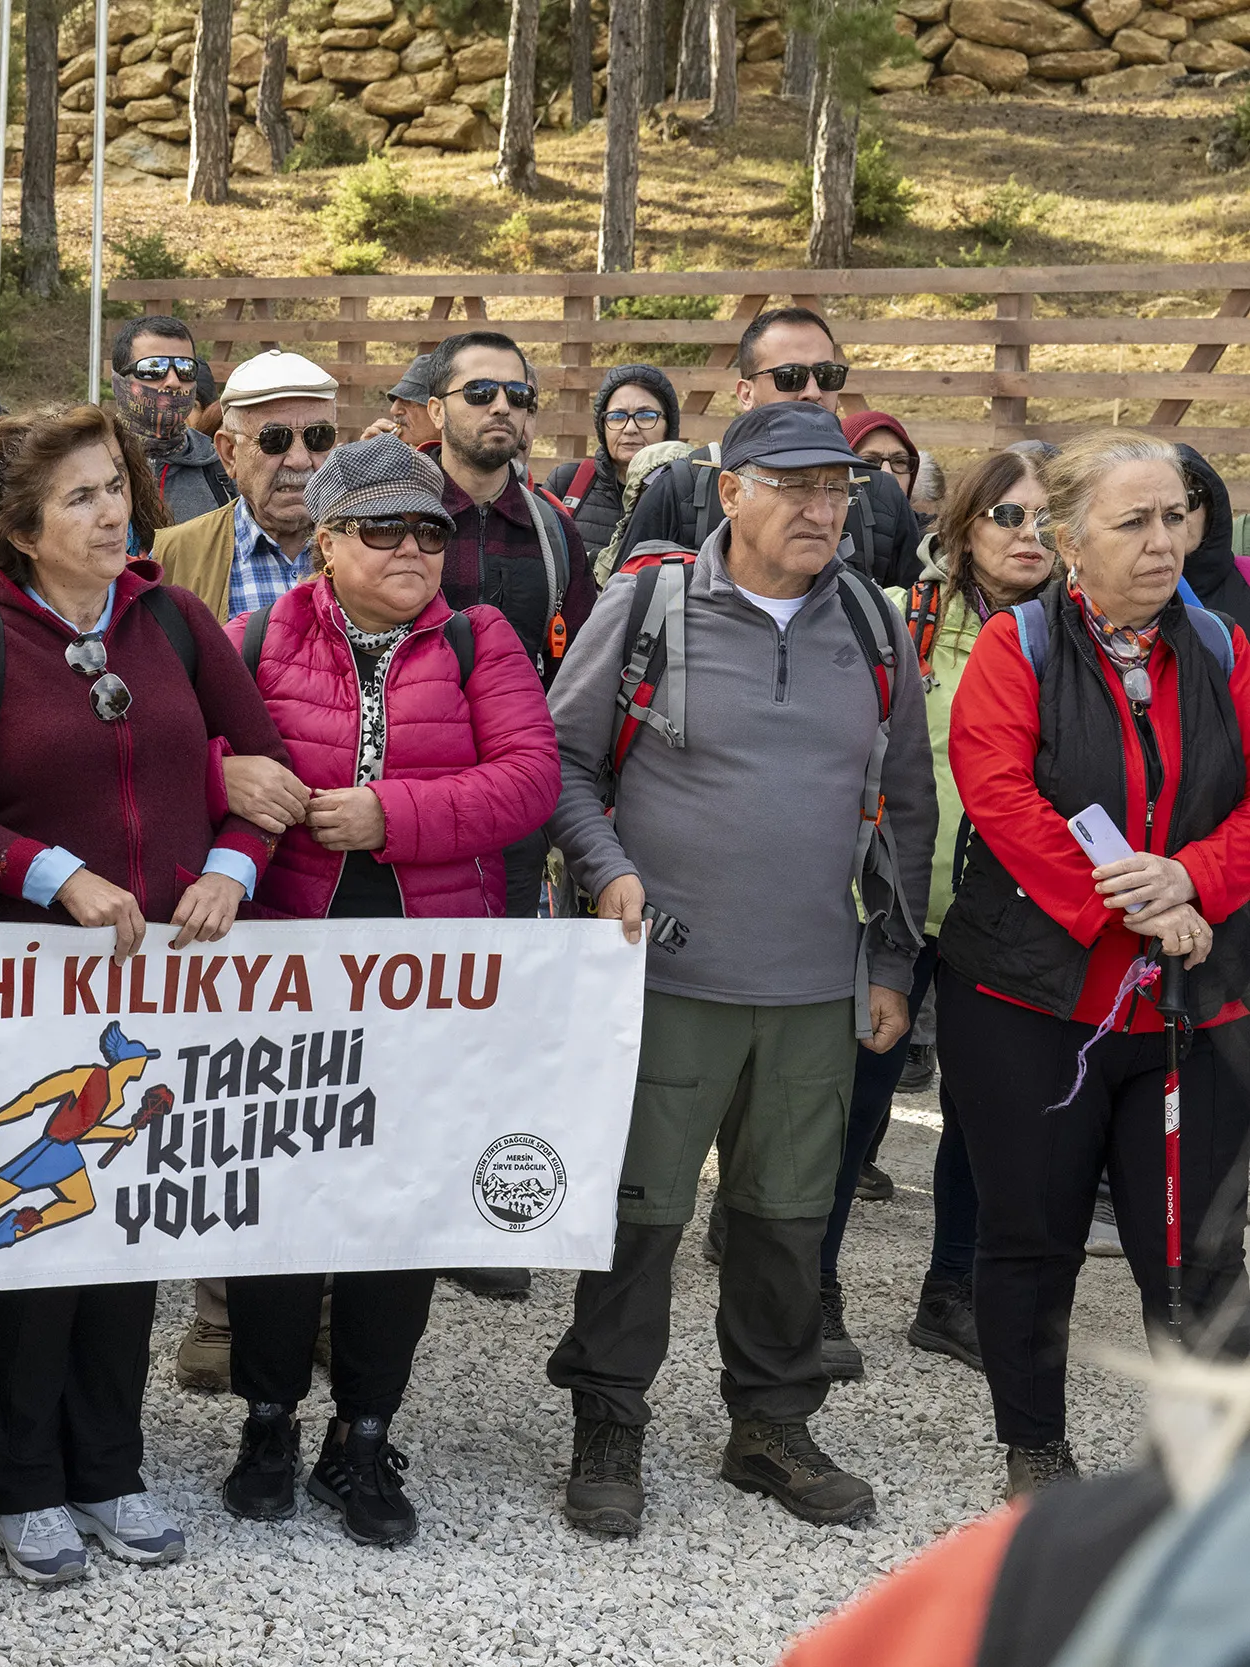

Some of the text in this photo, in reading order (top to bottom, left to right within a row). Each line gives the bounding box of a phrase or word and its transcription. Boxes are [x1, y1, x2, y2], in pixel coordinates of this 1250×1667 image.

[341, 953, 502, 1010] YOLU
[178, 1028, 364, 1104] TARİHİ
[147, 1087, 376, 1175] KİLİKYA
[506, 1153, 533, 1161] MERSİN
[476, 1158, 488, 1186] MERSİN
[486, 1141, 503, 1159] ZİRVE
[535, 1142, 553, 1158] SPOR
[492, 1163, 547, 1171] ZİRVE DAĞCILIK
[115, 1167, 259, 1245] YOLU
[1166, 1176, 1175, 1225] Quechua
